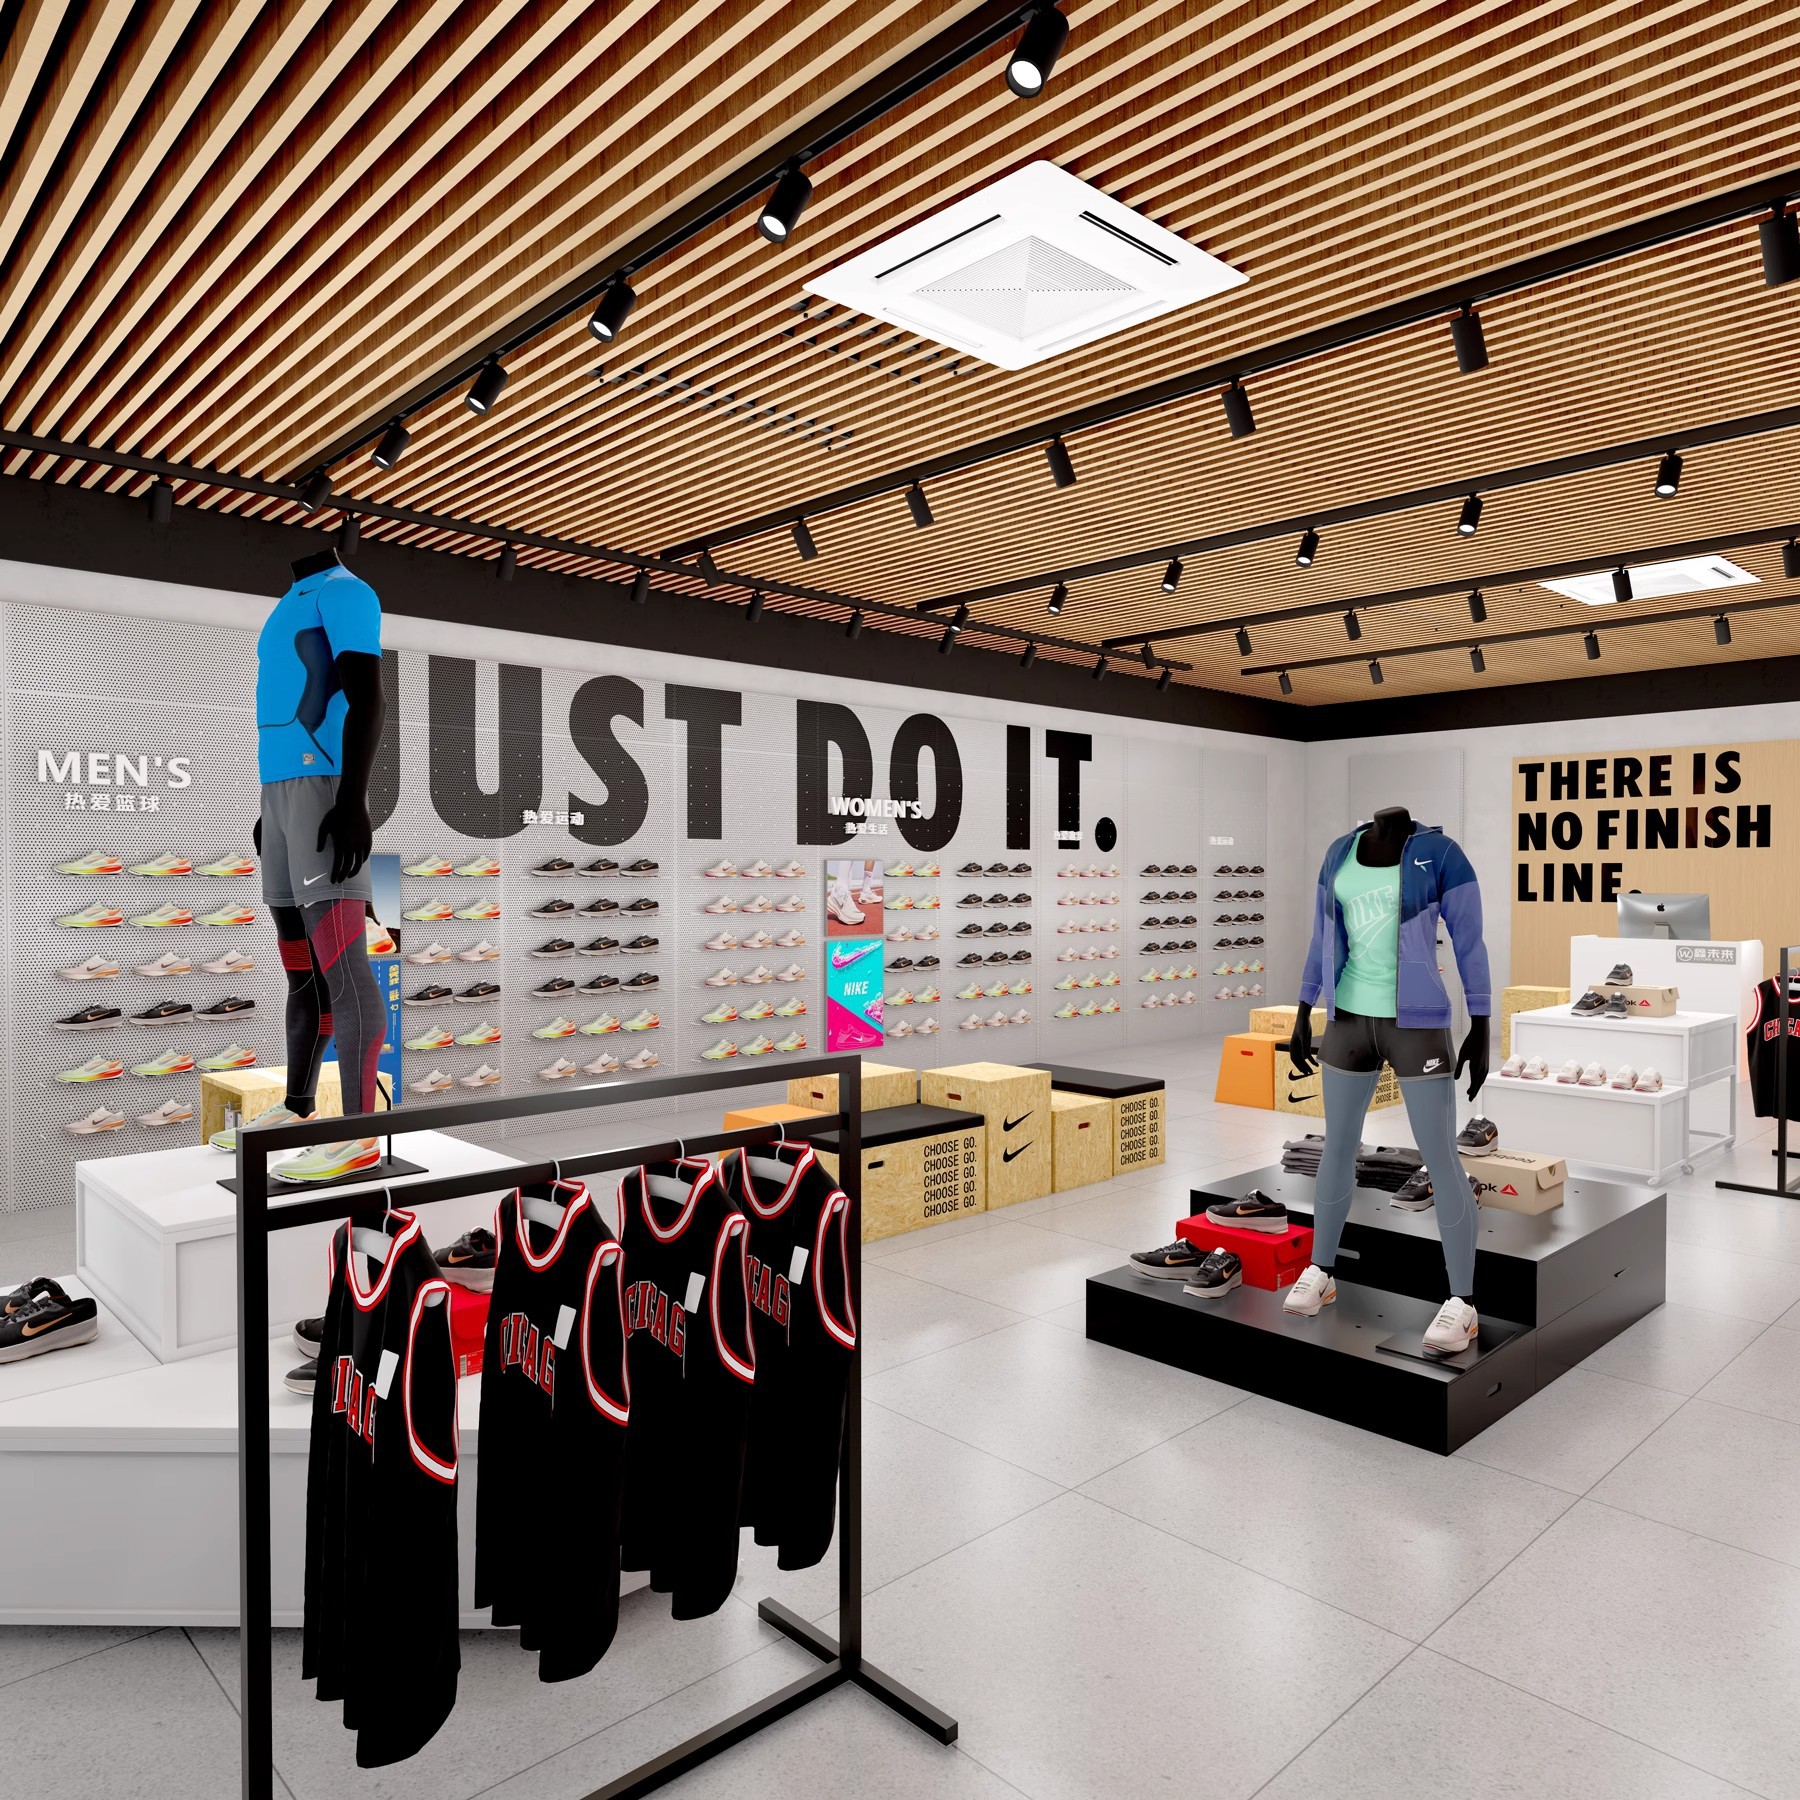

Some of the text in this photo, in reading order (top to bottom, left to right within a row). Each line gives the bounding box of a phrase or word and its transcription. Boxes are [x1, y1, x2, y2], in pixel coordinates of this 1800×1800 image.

[37, 749, 192, 788] MEN'S
[797, 699, 963, 852] DO
[1006, 724, 1117, 853] IT.
[1518, 750, 1741, 802] THERE IS
[64, 791, 160, 812] 热爱篮球
[832, 796, 923, 819] WOMEN'S
[522, 809, 585, 826] 热爱运动
[1518, 804, 1771, 851] NO FINISH
[1693, 948, 1735, 959] 鑫未来
[843, 981, 869, 997] NIKE
[1121, 1098, 1159, 1114] CHOOSE GO.
[1121, 1110, 1159, 1127] CHOOSE GO.
[1121, 1123, 1159, 1139] CHOOSE GO.
[924, 1137, 977, 1157] CHOOSE GO.
[1121, 1135, 1159, 1152] CHOOSE GO.
[924, 1151, 977, 1172] CHOOSE GO.
[1121, 1148, 1159, 1165] CHOOSE GO.
[1487, 1153, 1536, 1164] Reebo
[924, 1166, 977, 1187] CHOOSE GO.
[924, 1181, 977, 1202] CHOOSE GO.
[924, 1195, 977, 1218] CHOOSE GO.
